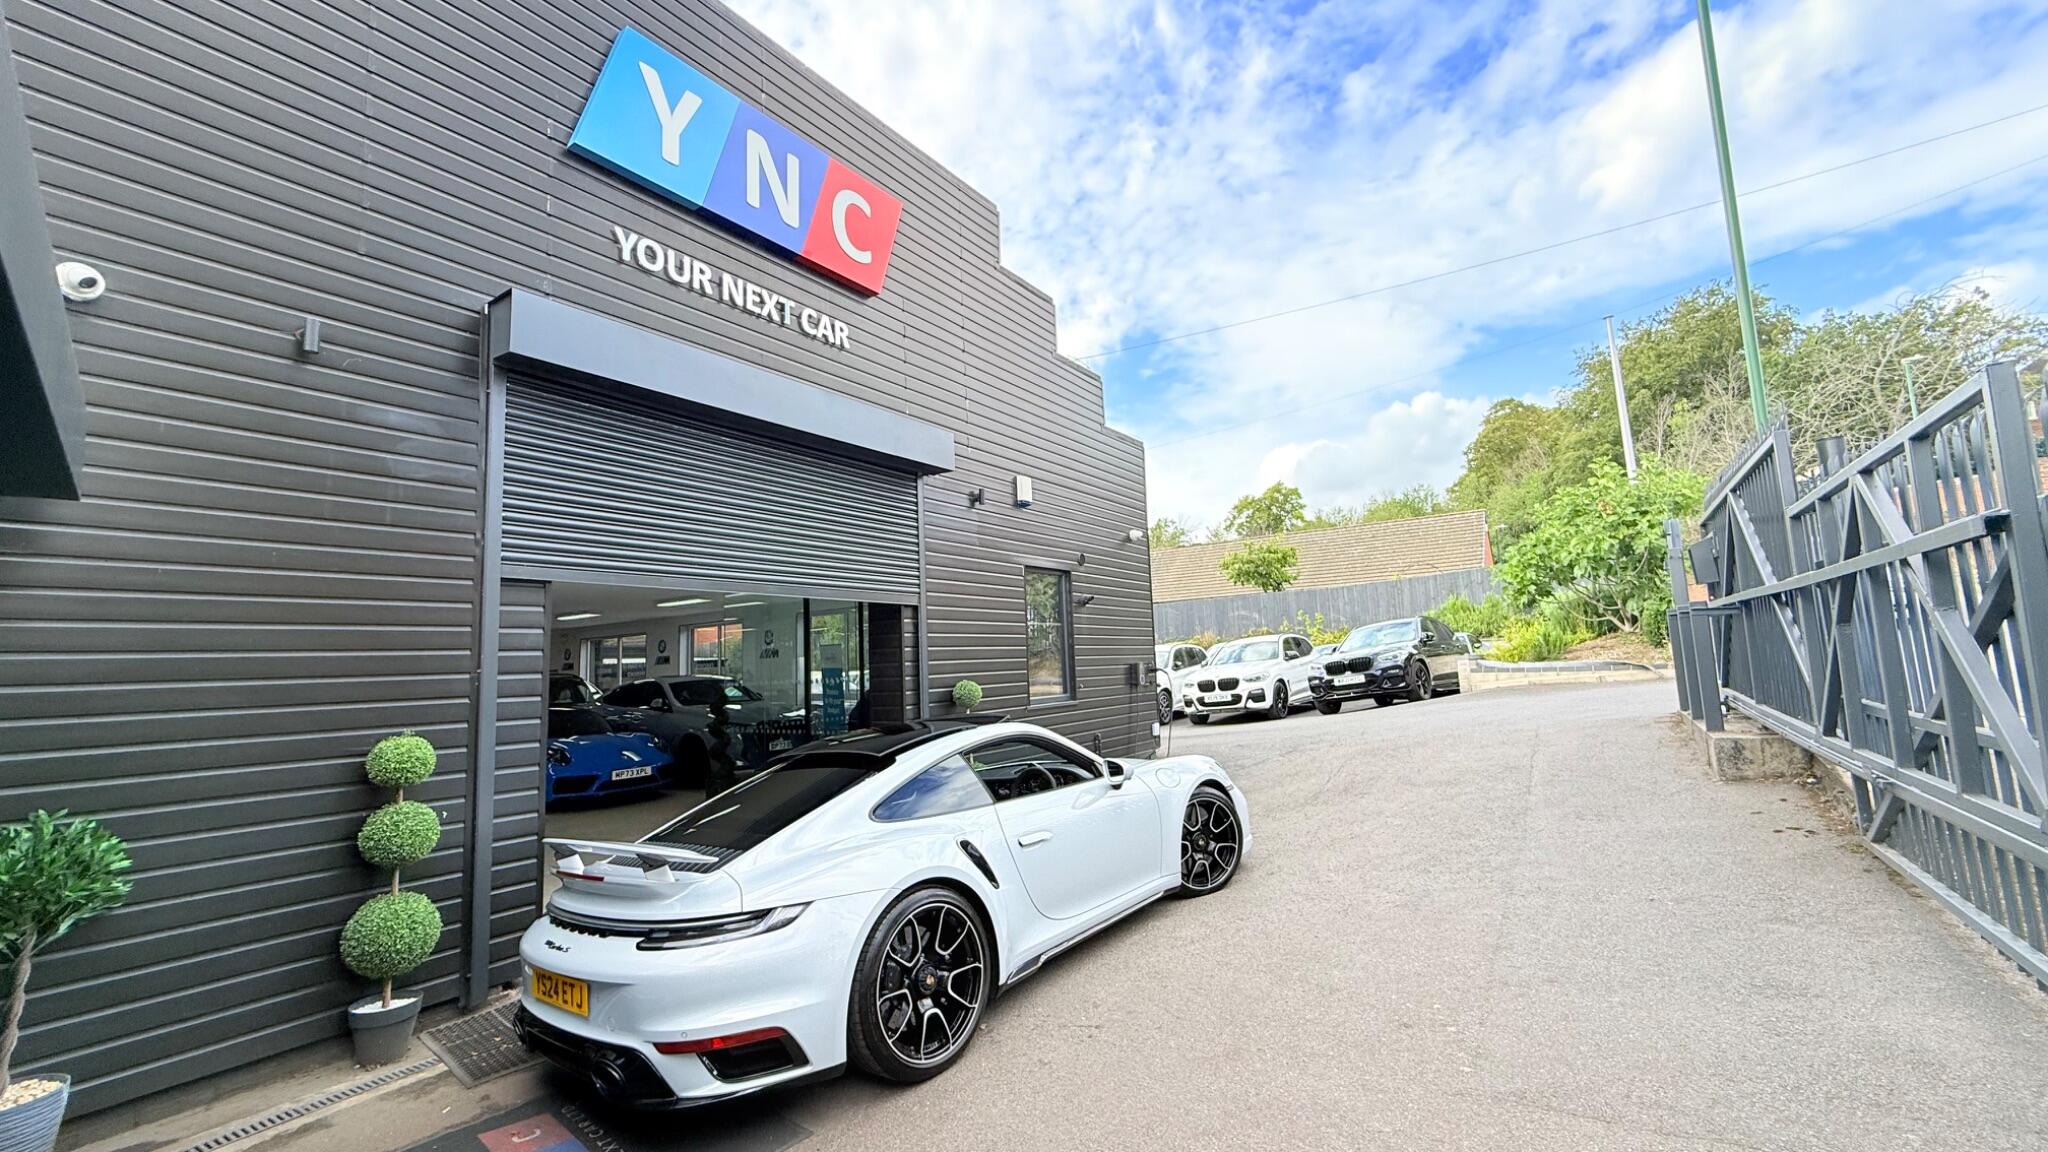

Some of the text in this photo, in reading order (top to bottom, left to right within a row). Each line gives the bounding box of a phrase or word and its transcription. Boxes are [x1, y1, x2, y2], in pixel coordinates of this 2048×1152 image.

[613, 226, 851, 349] YOUR NEXT CAR
[535, 969, 583, 1010] YS24 ETJ
